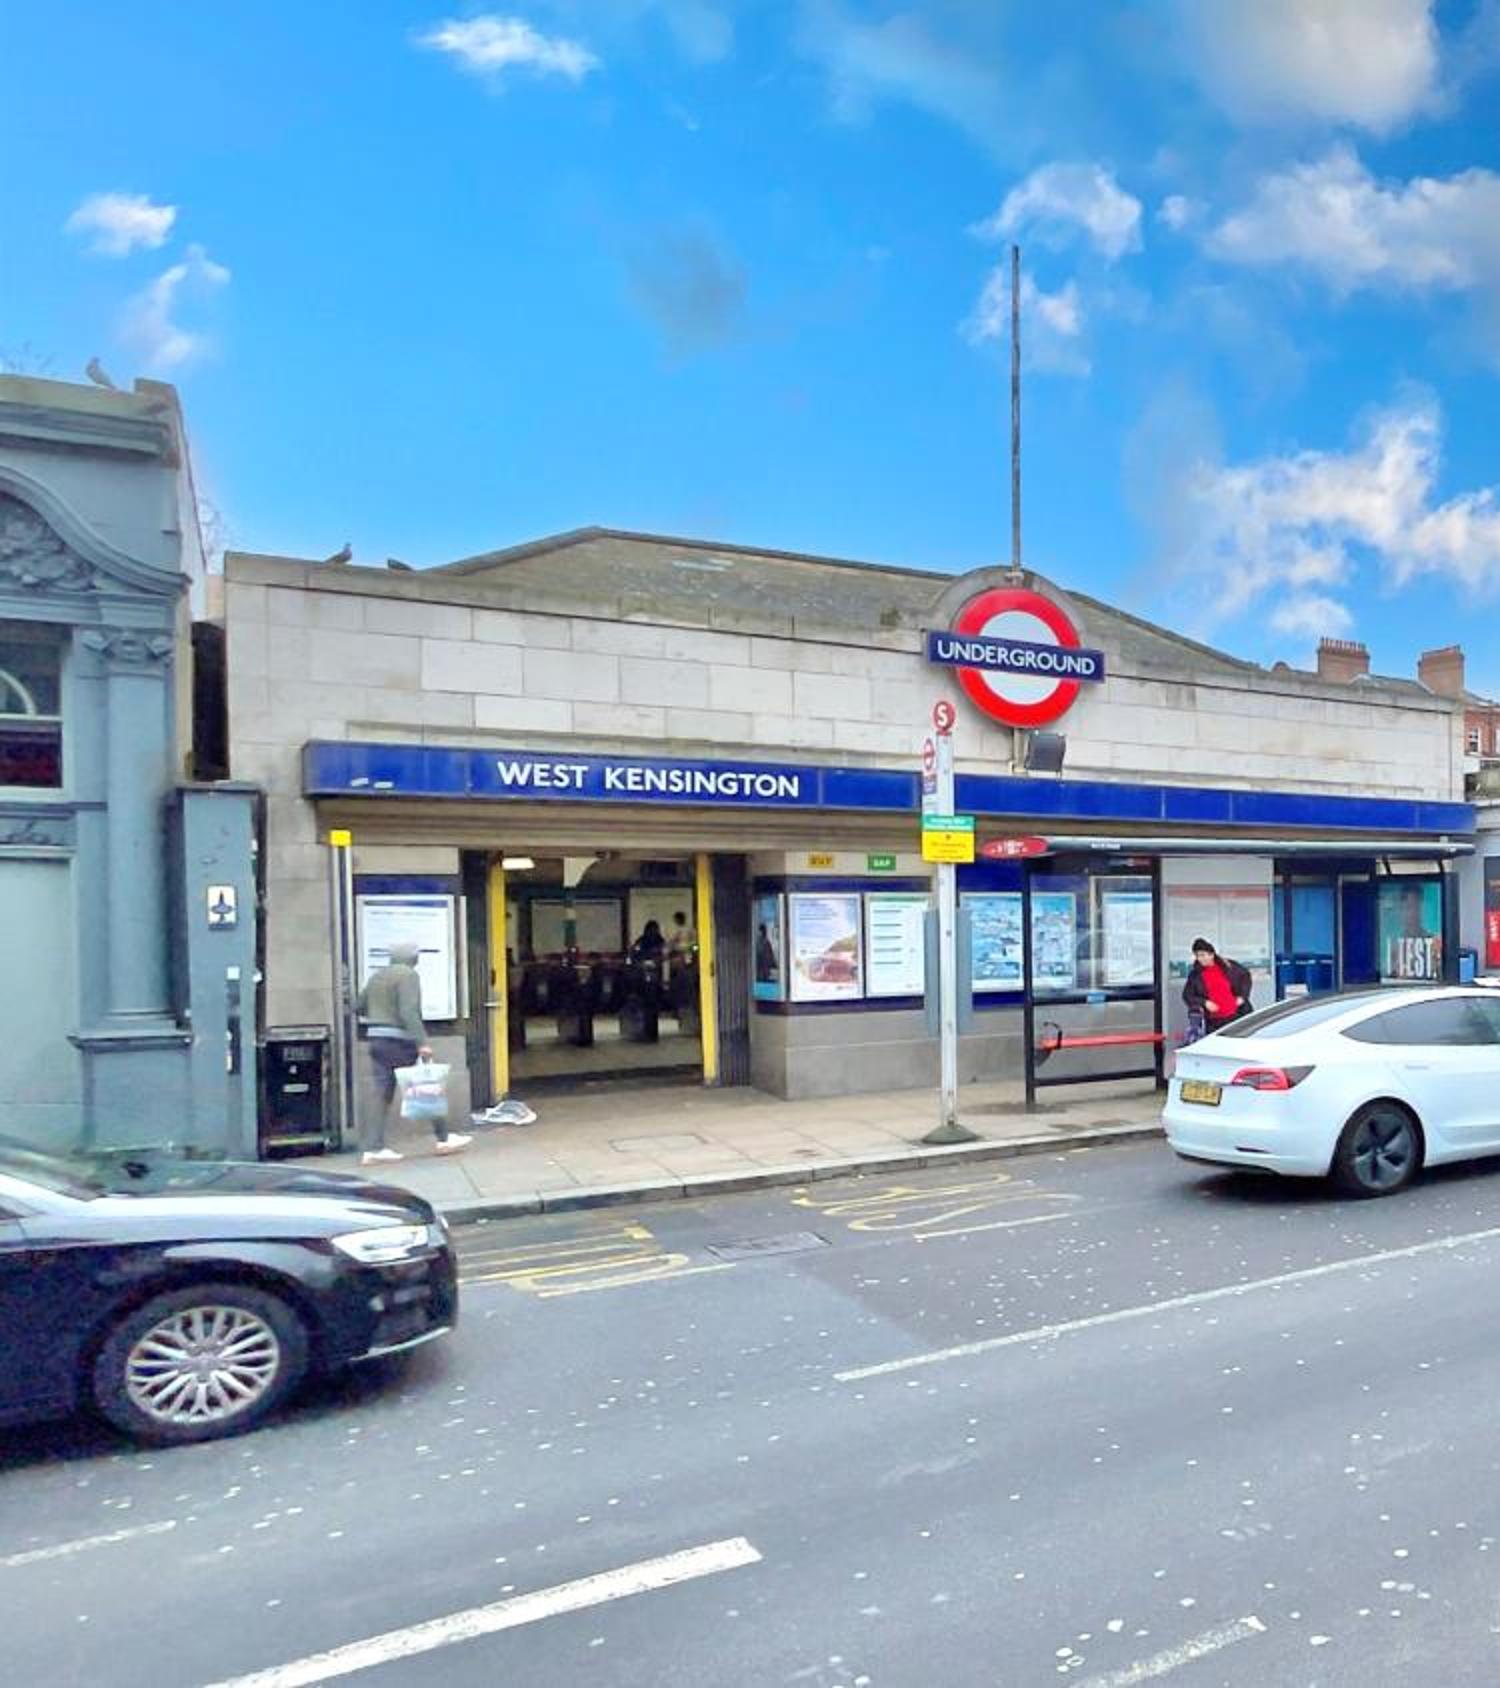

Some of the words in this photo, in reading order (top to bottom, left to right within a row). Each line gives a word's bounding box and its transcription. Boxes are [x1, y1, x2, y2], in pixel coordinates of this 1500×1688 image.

[937, 639, 1096, 675] UNDERGROUND
[937, 702, 948, 727] S
[497, 761, 588, 789] WEST
[603, 767, 799, 798] KENSINGTON
